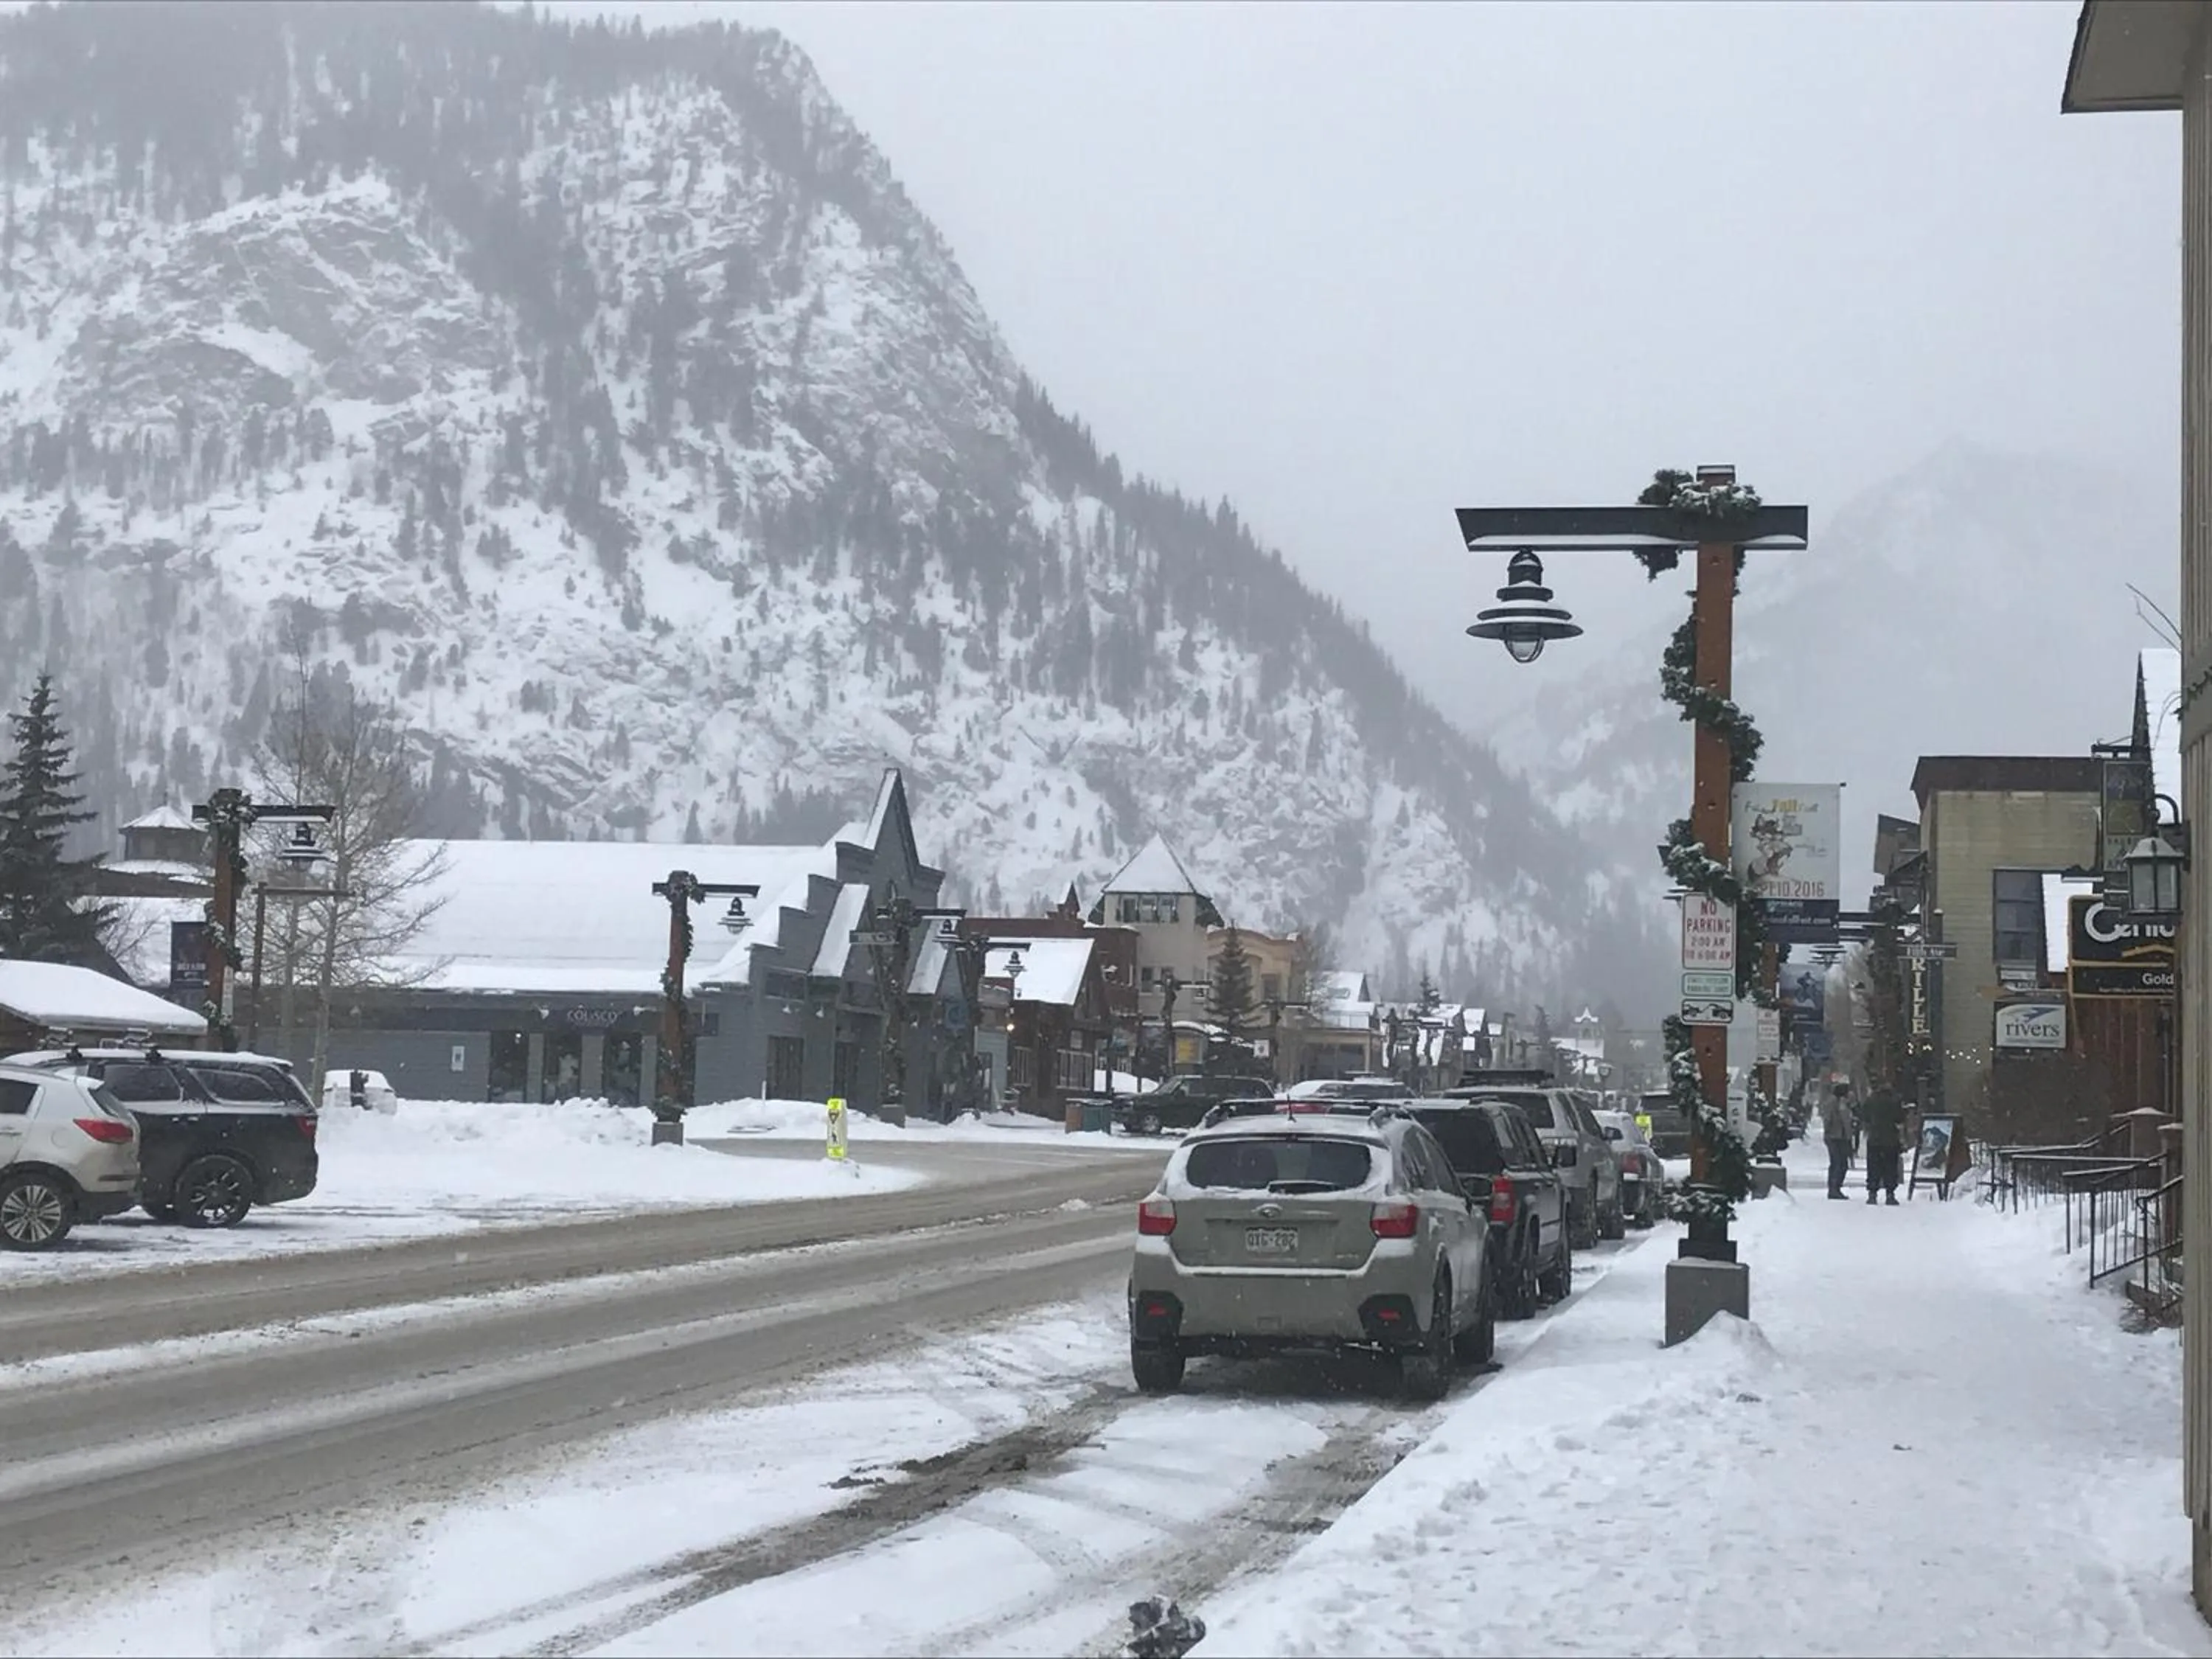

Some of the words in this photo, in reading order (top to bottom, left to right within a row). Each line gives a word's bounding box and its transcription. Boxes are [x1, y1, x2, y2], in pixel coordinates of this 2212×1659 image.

[1700, 900, 1717, 915] NO
[1686, 919, 1731, 933] PARKING
[2142, 973, 2174, 984] Gold
[1911, 957, 1930, 1034] RILLE
[2006, 1018, 2059, 1037] rivers
